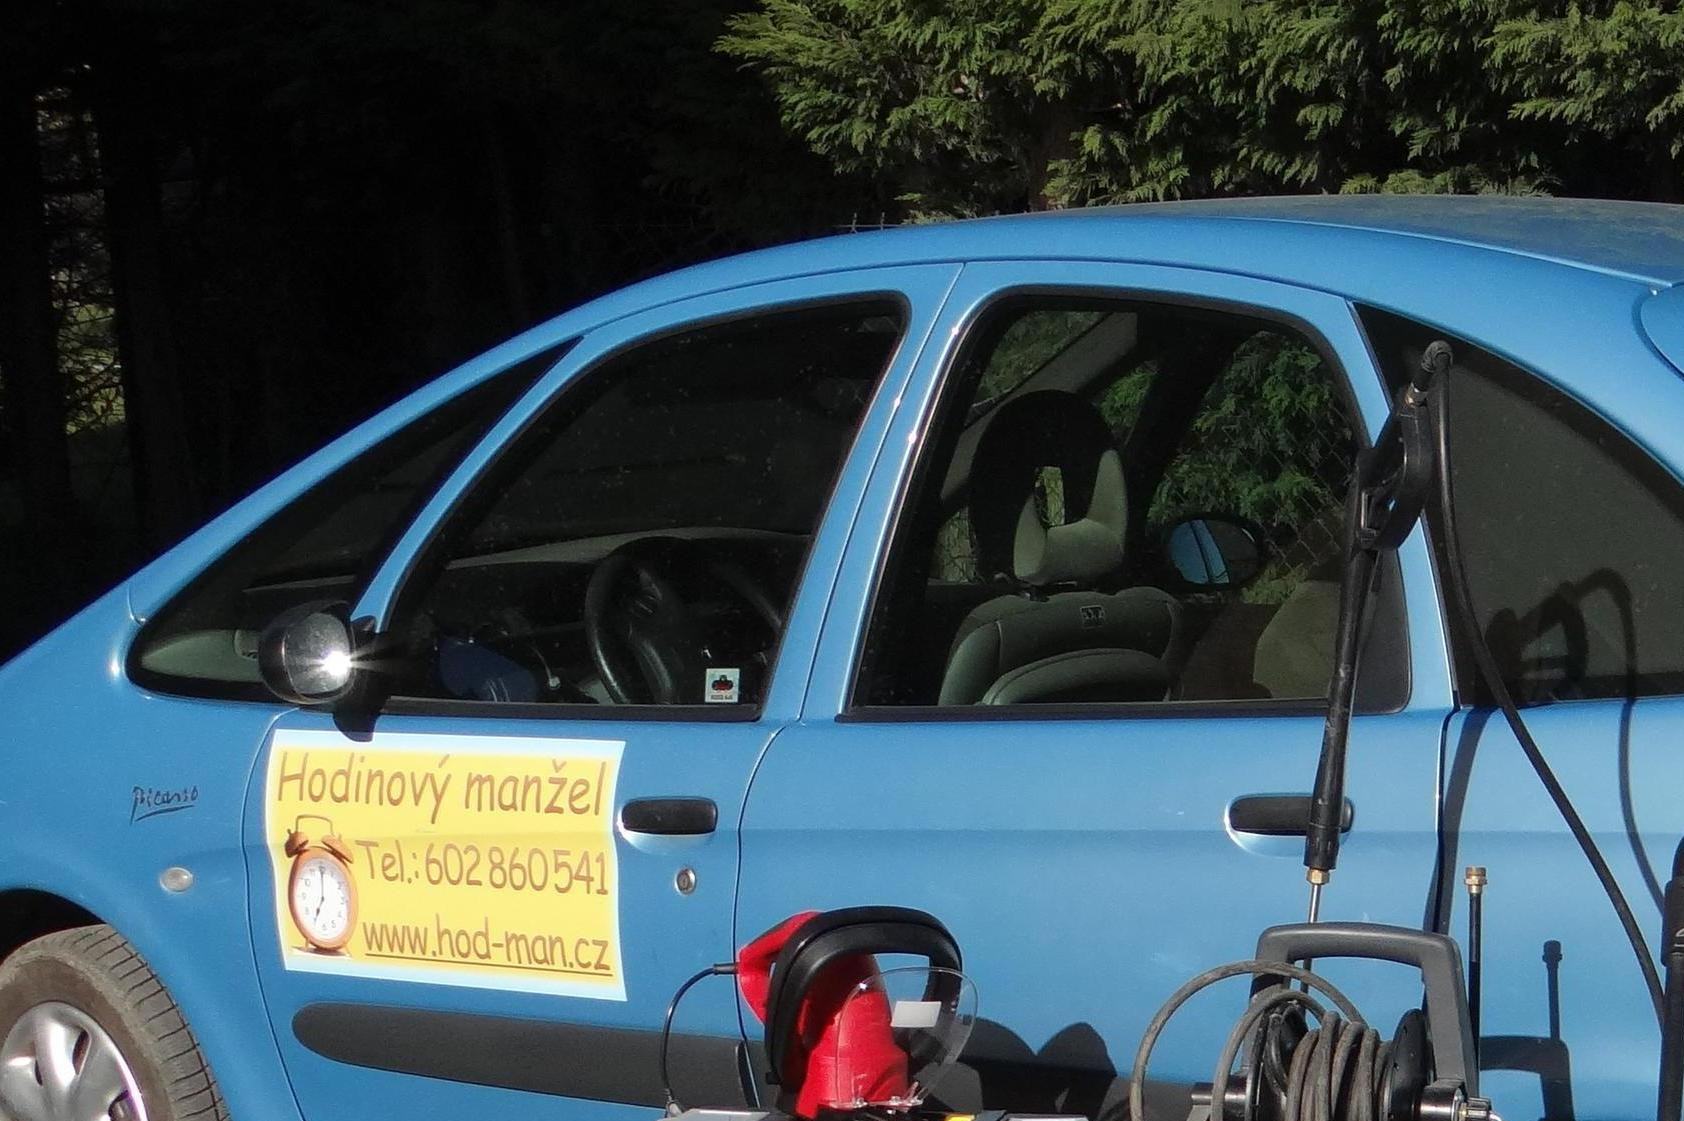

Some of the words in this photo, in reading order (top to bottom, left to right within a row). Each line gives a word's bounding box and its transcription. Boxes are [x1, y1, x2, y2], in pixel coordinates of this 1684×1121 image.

[277, 751, 452, 825] Hodinový
[464, 758, 607, 816] manžel
[362, 913, 611, 971] www.hod-man.cz
